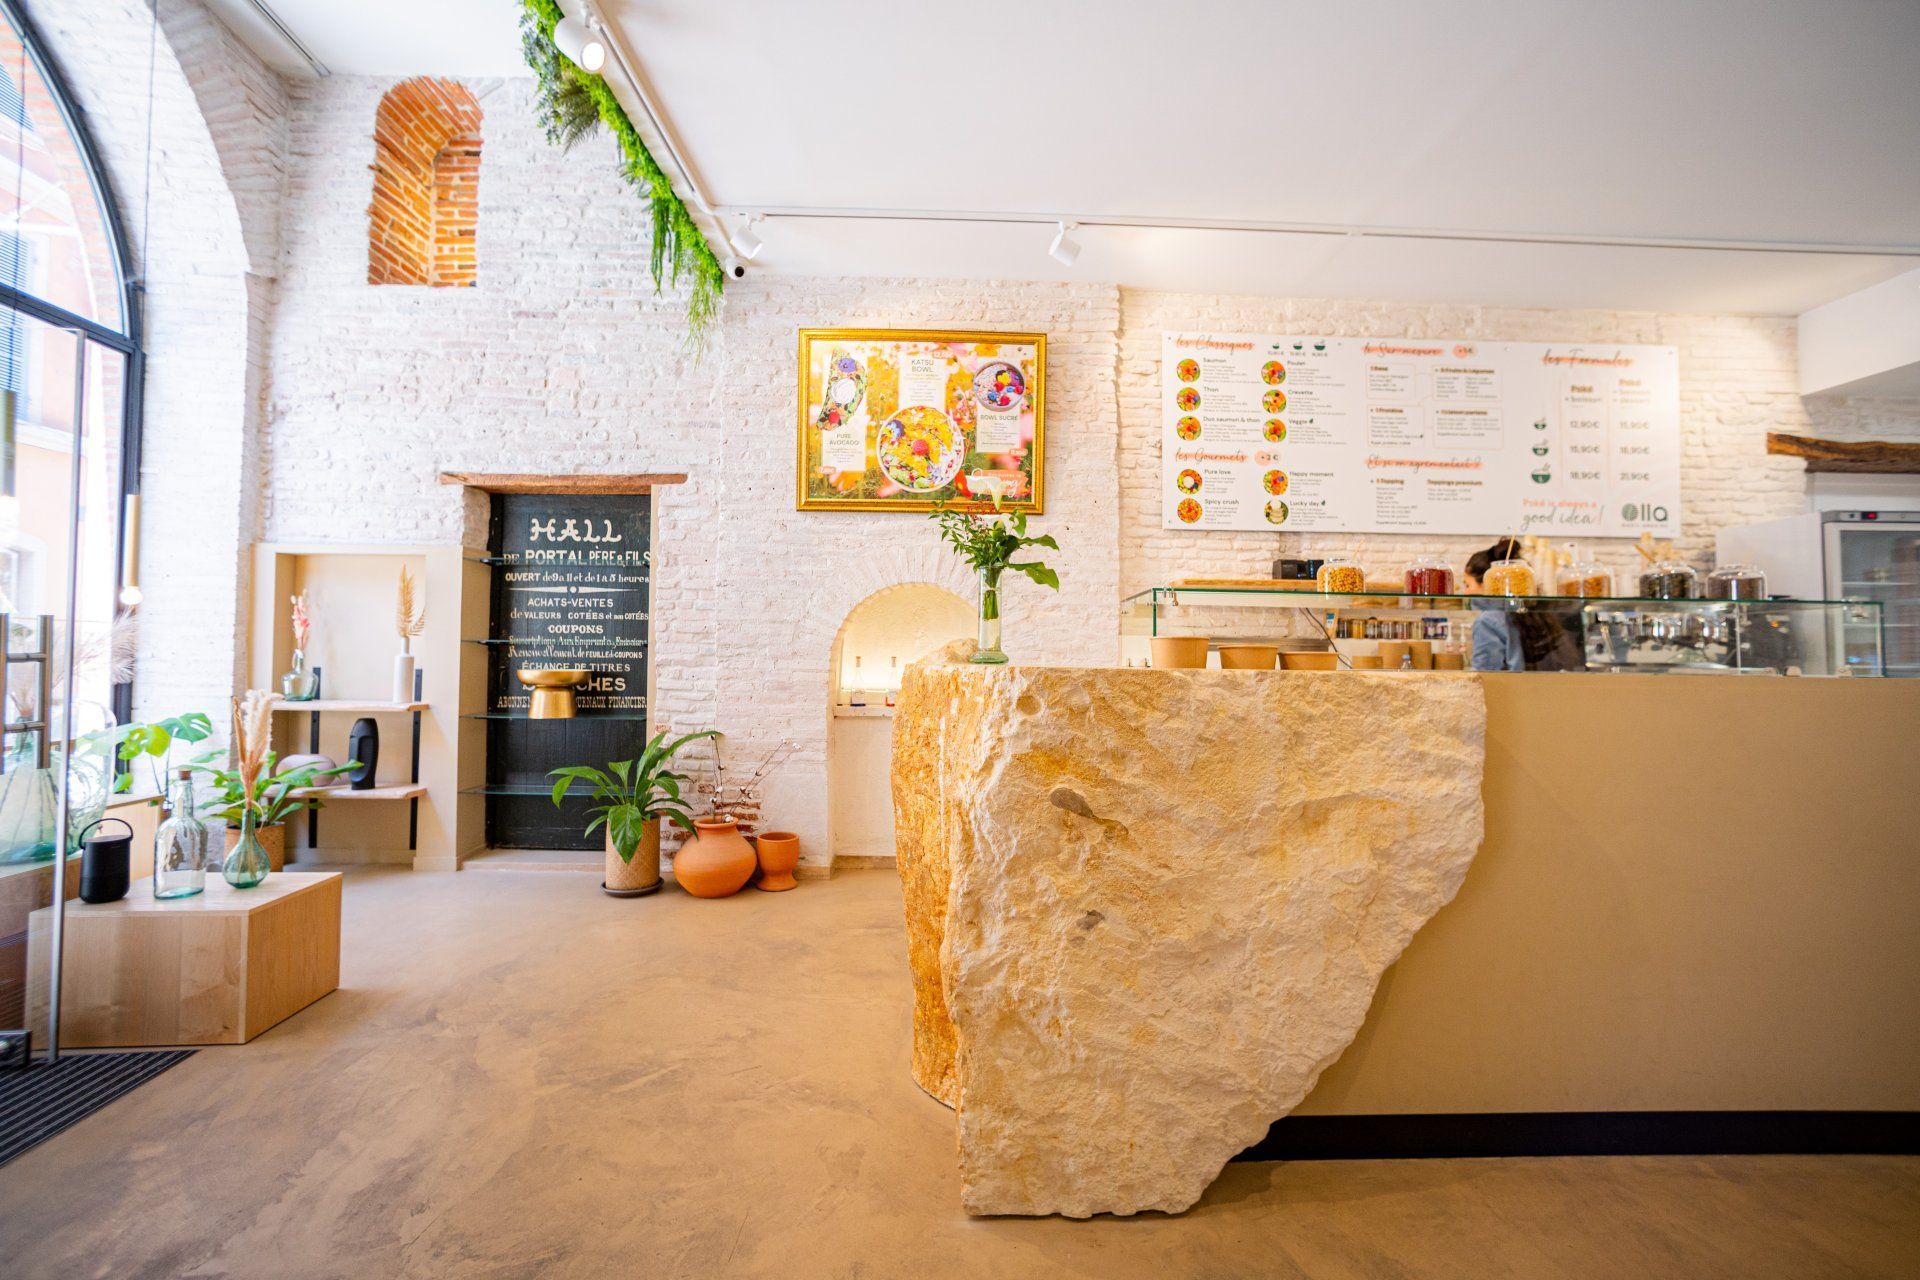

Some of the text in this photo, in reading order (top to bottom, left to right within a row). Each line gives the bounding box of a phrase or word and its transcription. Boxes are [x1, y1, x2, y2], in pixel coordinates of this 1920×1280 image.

[1195, 334, 1253, 356] Classiques
[1195, 447, 1247, 464] Gourmets
[1520, 506, 1556, 532] good
[530, 518, 622, 542] HALL
[525, 549, 588, 565] PORTAL
[589, 545, 616, 565] PÈRE
[616, 554, 626, 567] &
[625, 550, 650, 565] FILS
[505, 572, 541, 582] OUVERT
[573, 572, 583, 582] et
[584, 572, 596, 583] de
[618, 573, 650, 584] heures
[527, 598, 614, 608] ACHATS-VENTES
[510, 608, 524, 619] de
[524, 612, 561, 620] VALEURS
[567, 609, 604, 620] COTÉES
[605, 611, 613, 620] et
[624, 610, 649, 621] COTÉES
[547, 624, 604, 634] COUPONS
[614, 651, 643, 659] COUPONS
[522, 660, 631, 672] ÉCHANGE DE TITRES
